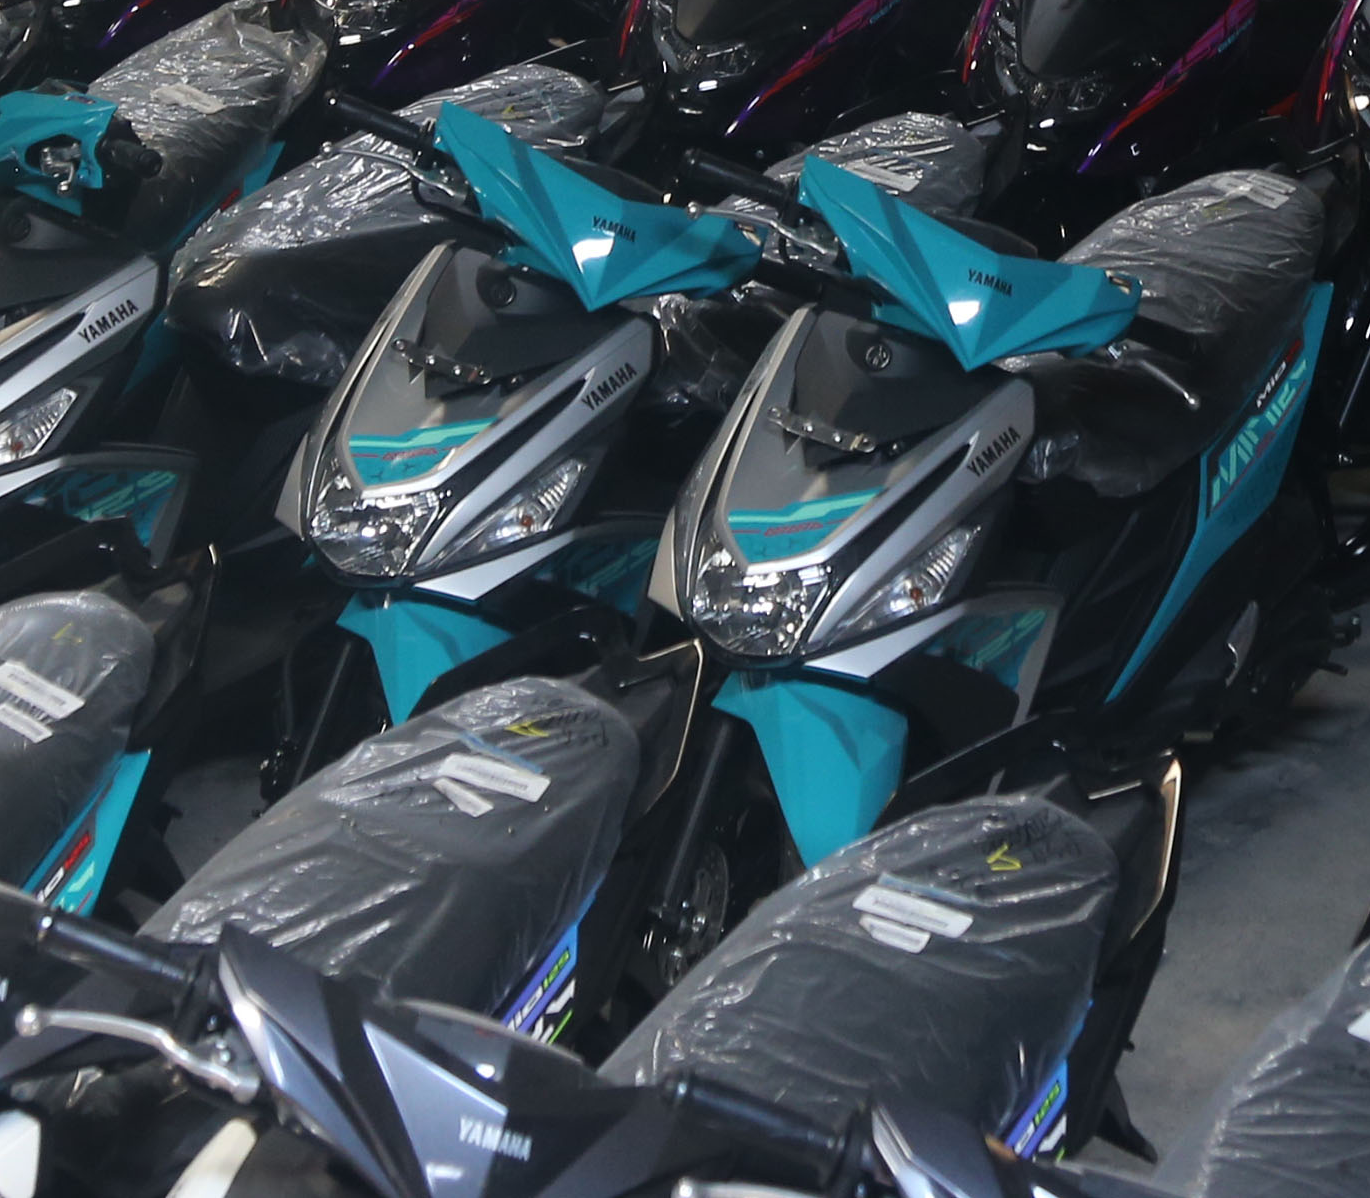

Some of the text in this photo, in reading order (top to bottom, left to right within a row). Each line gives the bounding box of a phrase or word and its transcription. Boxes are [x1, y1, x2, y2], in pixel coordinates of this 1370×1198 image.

[592, 215, 636, 243] YAMAHA
[968, 268, 1013, 297] YAMAHA
[78, 299, 139, 344] YAMAHA
[581, 363, 638, 411] YAMAHA
[967, 427, 1022, 477] YAMAHA
[459, 1116, 532, 1162] YAMAHA
